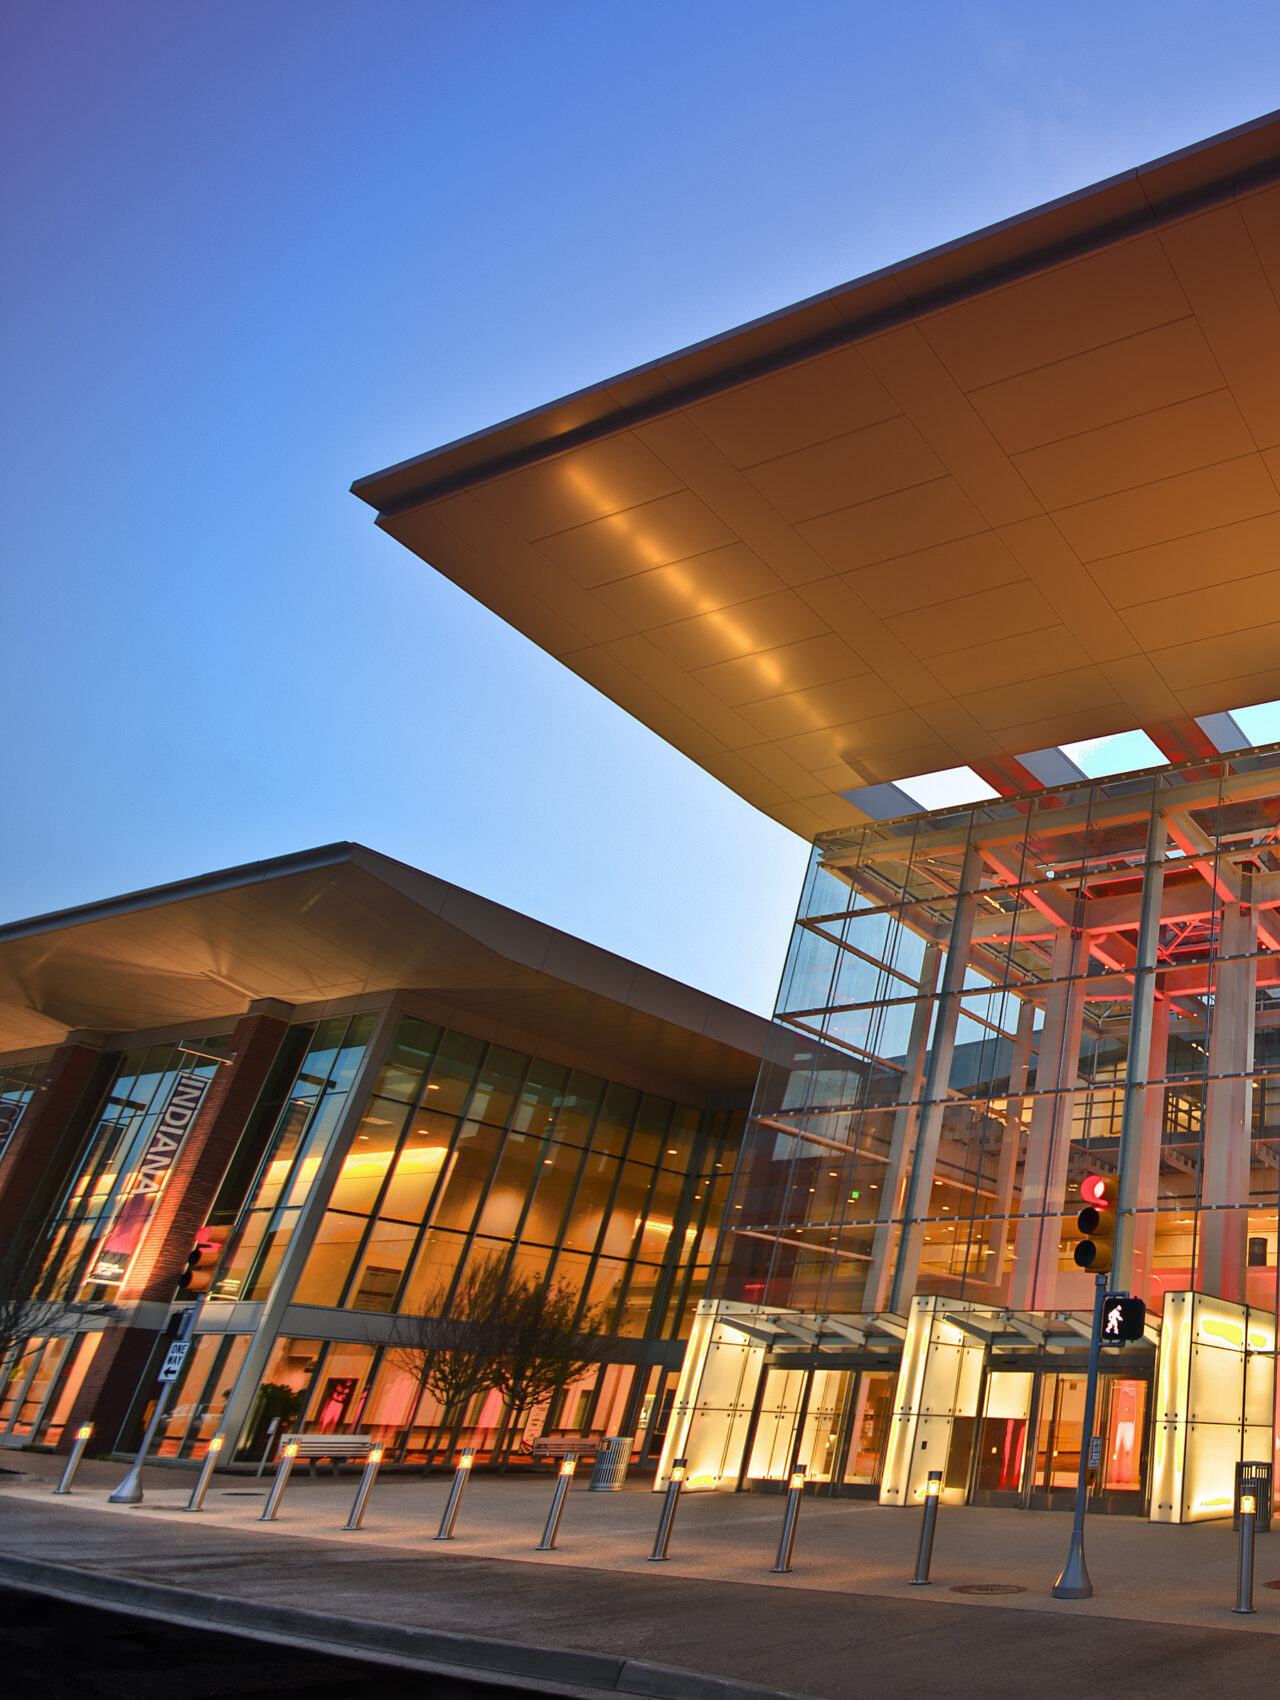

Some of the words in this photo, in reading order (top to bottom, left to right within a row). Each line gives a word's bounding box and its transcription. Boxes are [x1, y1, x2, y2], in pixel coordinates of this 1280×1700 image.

[132, 1078, 205, 1195] INDIANA
[171, 1344, 187, 1354] ONE
[167, 1355, 183, 1365] WAY
